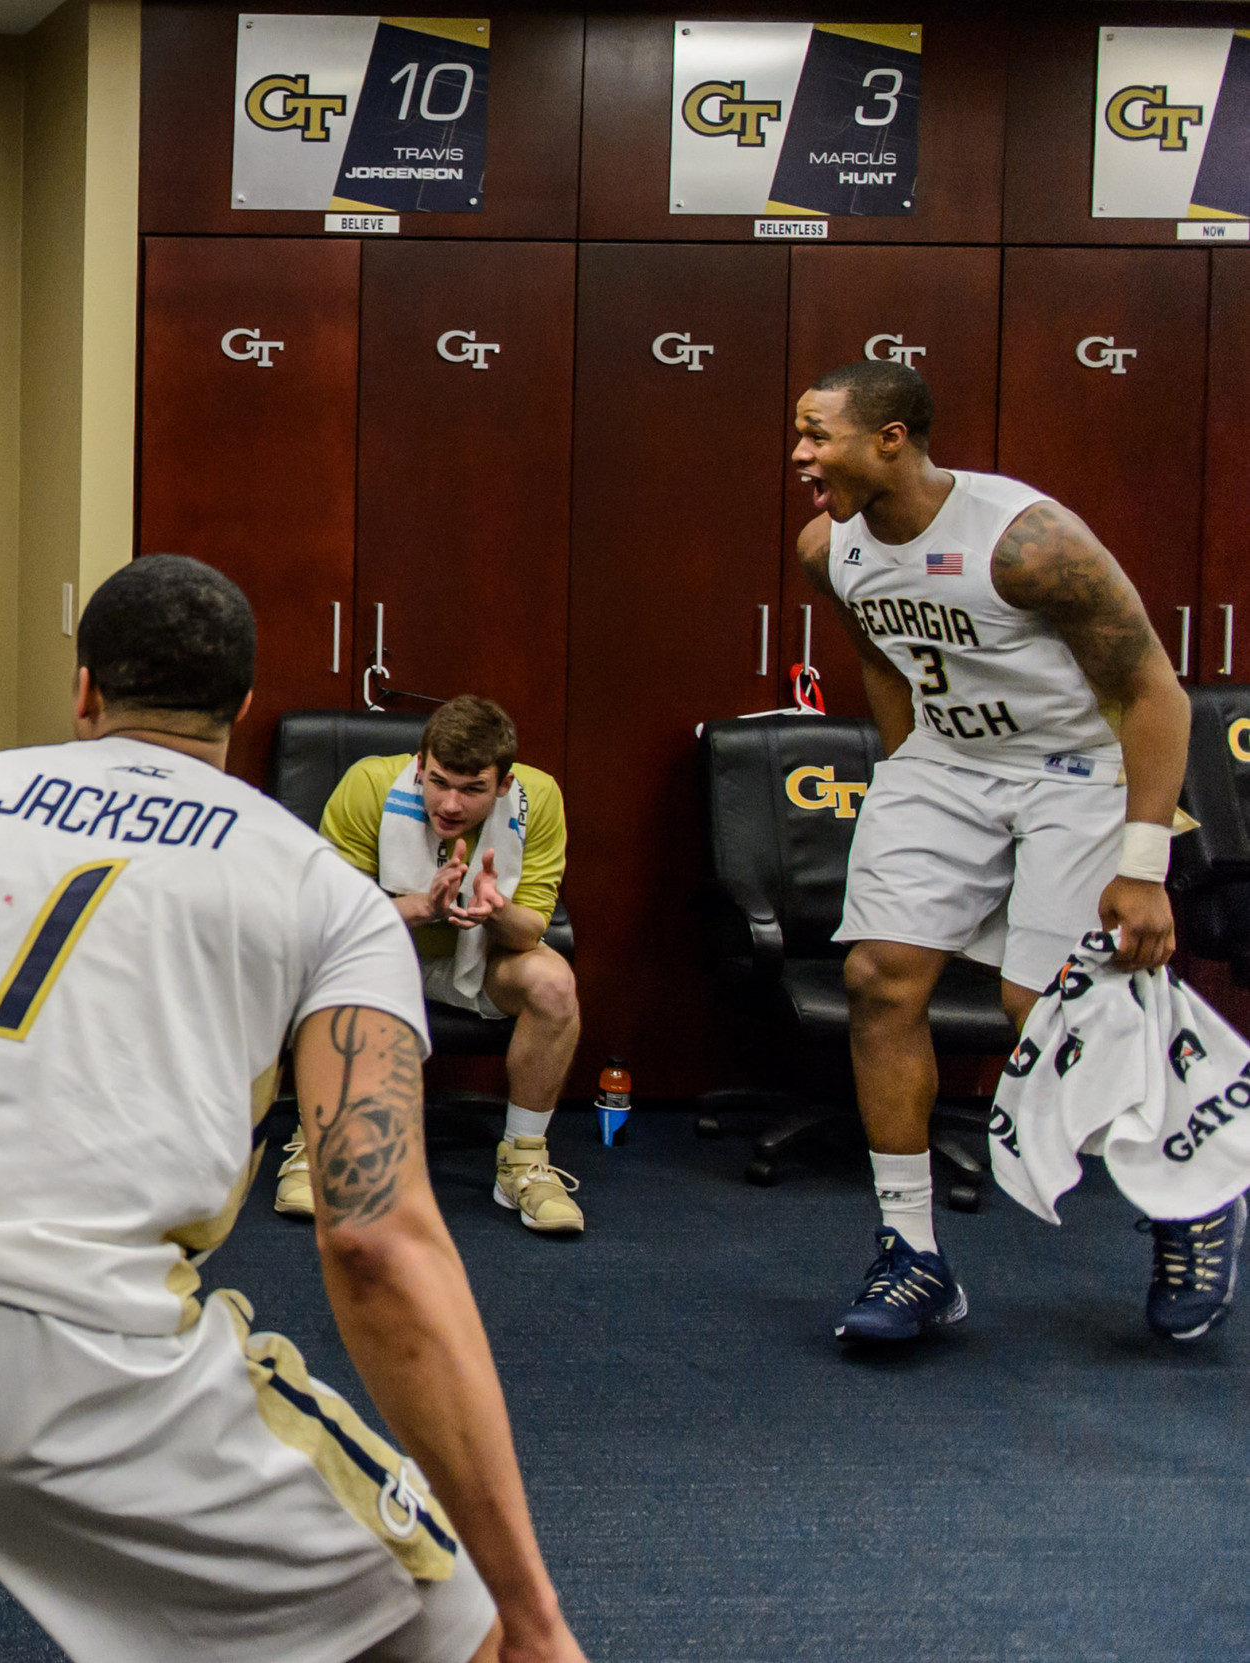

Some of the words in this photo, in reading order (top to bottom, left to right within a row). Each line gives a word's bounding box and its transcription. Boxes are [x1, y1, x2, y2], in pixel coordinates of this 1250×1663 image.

[245, 74, 346, 142] GT
[390, 62, 474, 121] 10
[854, 68, 903, 126] 3
[681, 80, 782, 147] GT
[1105, 85, 1203, 151] GT
[345, 167, 463, 180] JORGENSON
[393, 147, 464, 162] TRAVIS
[809, 152, 896, 165] MARCUS
[839, 172, 896, 184] HUNT
[341, 217, 384, 231] BELIEVE
[759, 222, 824, 236] RELENTLESS
[1202, 225, 1225, 237] NOW
[221, 328, 284, 367] GT
[436, 330, 500, 369] GT
[652, 332, 714, 371] GT
[864, 334, 926, 370] GT
[1076, 336, 1137, 374] GT
[908, 644, 949, 696] 3
[922, 701, 1020, 739] ECH
[786, 765, 868, 818] GT
[1163, 1062, 1250, 1162] GATO
